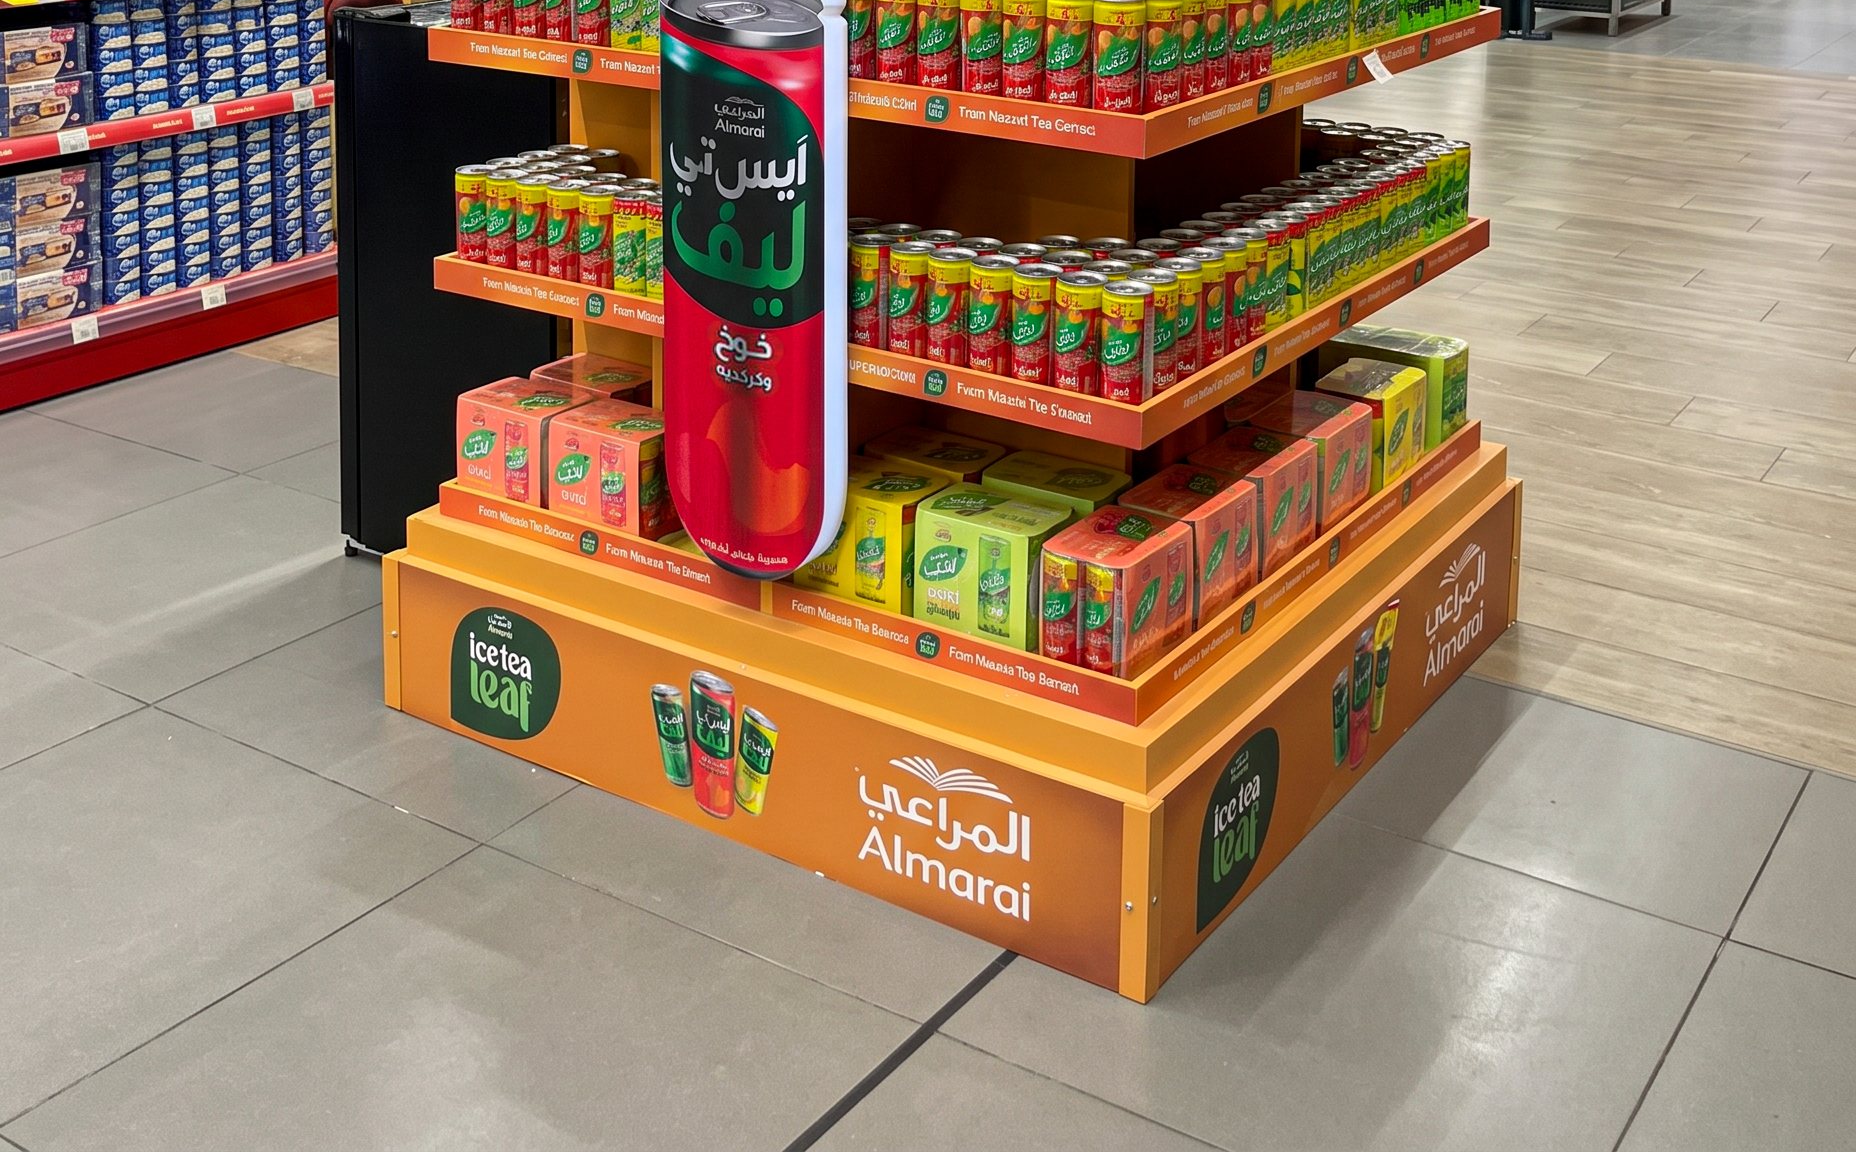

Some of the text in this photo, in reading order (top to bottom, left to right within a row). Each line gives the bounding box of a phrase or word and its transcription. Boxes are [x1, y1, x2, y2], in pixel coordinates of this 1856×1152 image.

[714, 117, 766, 139] Almarai
[668, 135, 717, 197] تي
[670, 199, 807, 318] ليف
[713, 323, 774, 364] خوخ
[715, 363, 773, 393] وكركديه
[1424, 550, 1487, 645] المراعي
[469, 631, 532, 681] ice tea
[1422, 599, 1484, 688] Almarai
[469, 659, 533, 733] leaf
[858, 775, 1031, 863] المراعي
[1238, 773, 1261, 815] tea
[857, 825, 1031, 922] Almarai
[1212, 799, 1260, 884] leaf
